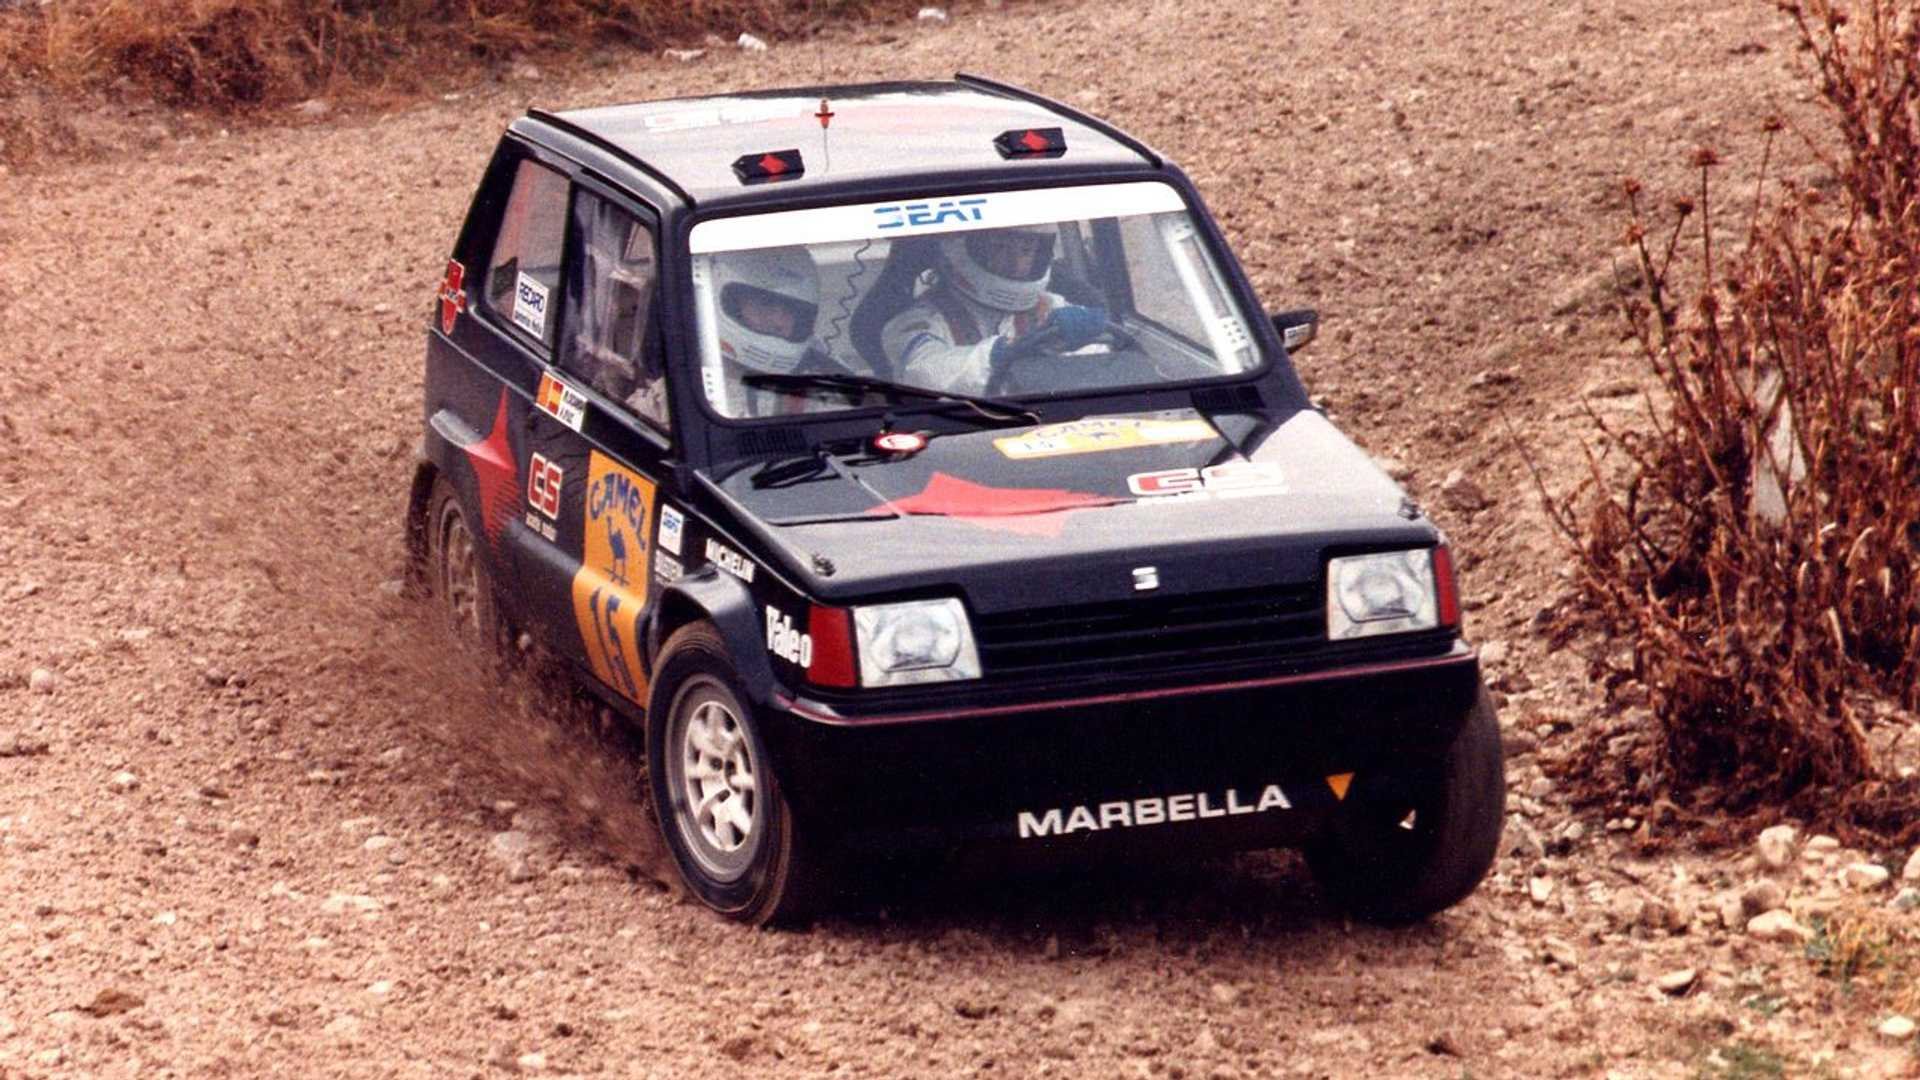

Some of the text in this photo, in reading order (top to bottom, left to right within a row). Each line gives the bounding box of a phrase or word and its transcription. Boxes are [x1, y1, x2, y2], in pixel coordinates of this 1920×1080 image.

[873, 199, 987, 229] SEAT
[590, 472, 647, 551] CAMEL
[589, 586, 639, 700] 15
[765, 604, 813, 669] Valeo
[1018, 785, 1292, 838] MARBELLA
